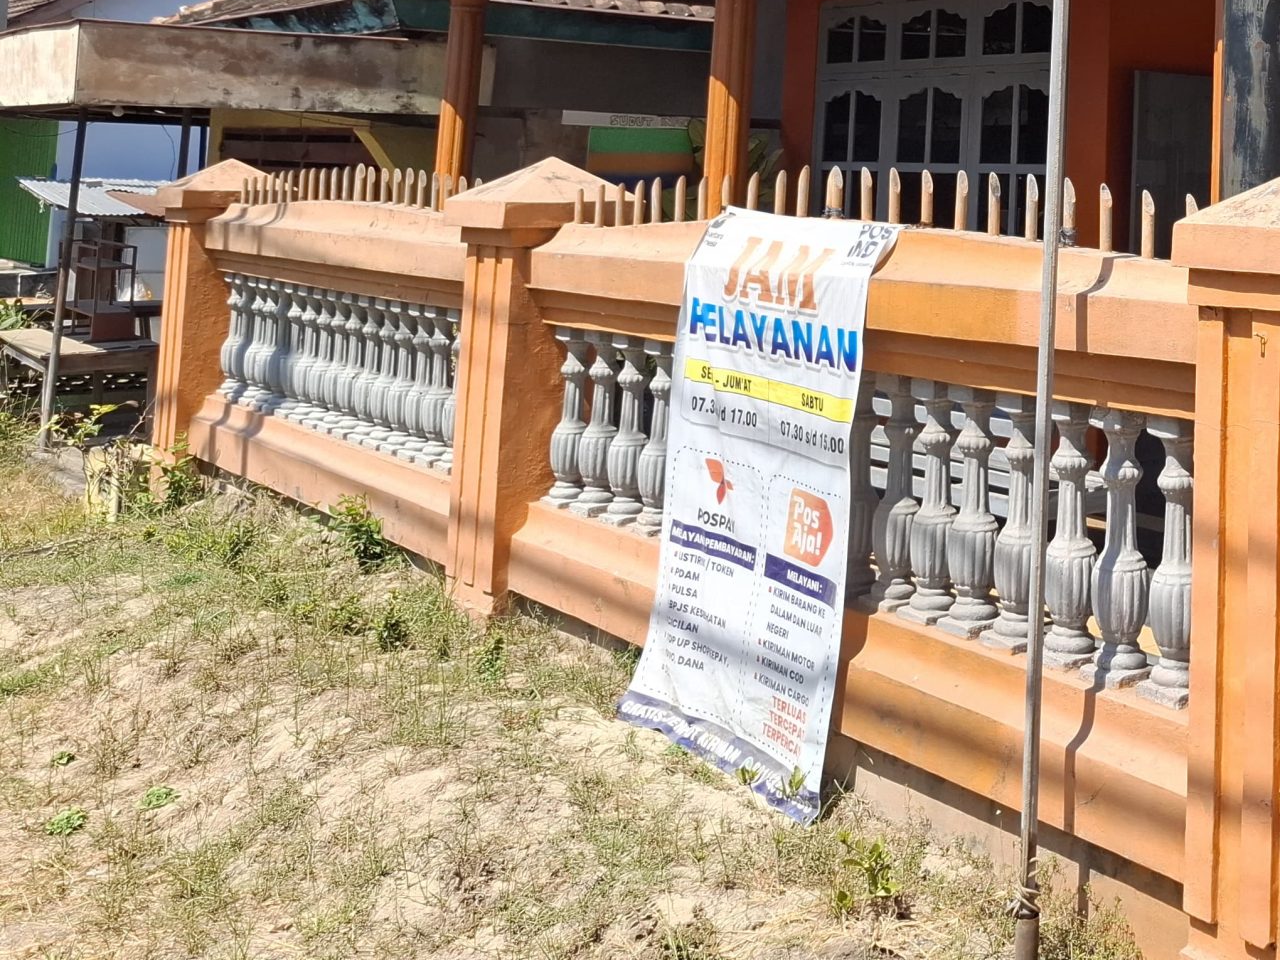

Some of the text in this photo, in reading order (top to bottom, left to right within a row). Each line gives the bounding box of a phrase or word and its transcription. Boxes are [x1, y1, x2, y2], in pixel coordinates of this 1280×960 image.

[859, 224, 896, 240] POS
[723, 236, 836, 311] JAM
[689, 297, 858, 372] PELAYANAN
[723, 375, 752, 391] JUM'AT
[691, 396, 715, 413] 07.3
[730, 408, 757, 427] 17.00
[801, 393, 823, 411] SABTU
[780, 421, 803, 442] 07.30
[806, 429, 816, 447] s/d
[793, 495, 820, 529] Pos
[792, 521, 822, 556] Aja!
[675, 567, 700, 581] PDAM
[712, 561, 734, 577] TOKEN
[672, 584, 697, 598] PULSA
[773, 587, 826, 619] KIRIM BARANG KE
[770, 604, 792, 621] DALAM
[792, 614, 806, 628] DAN
[766, 621, 789, 639] NEGERI
[677, 637, 691, 648] UP
[763, 640, 790, 660] KIRIMAN
[677, 656, 704, 671] DANA
[761, 656, 804, 684] KIRIMAN COD
[759, 674, 786, 695] KIRIMAN
[772, 695, 806, 724] TERLUAS
